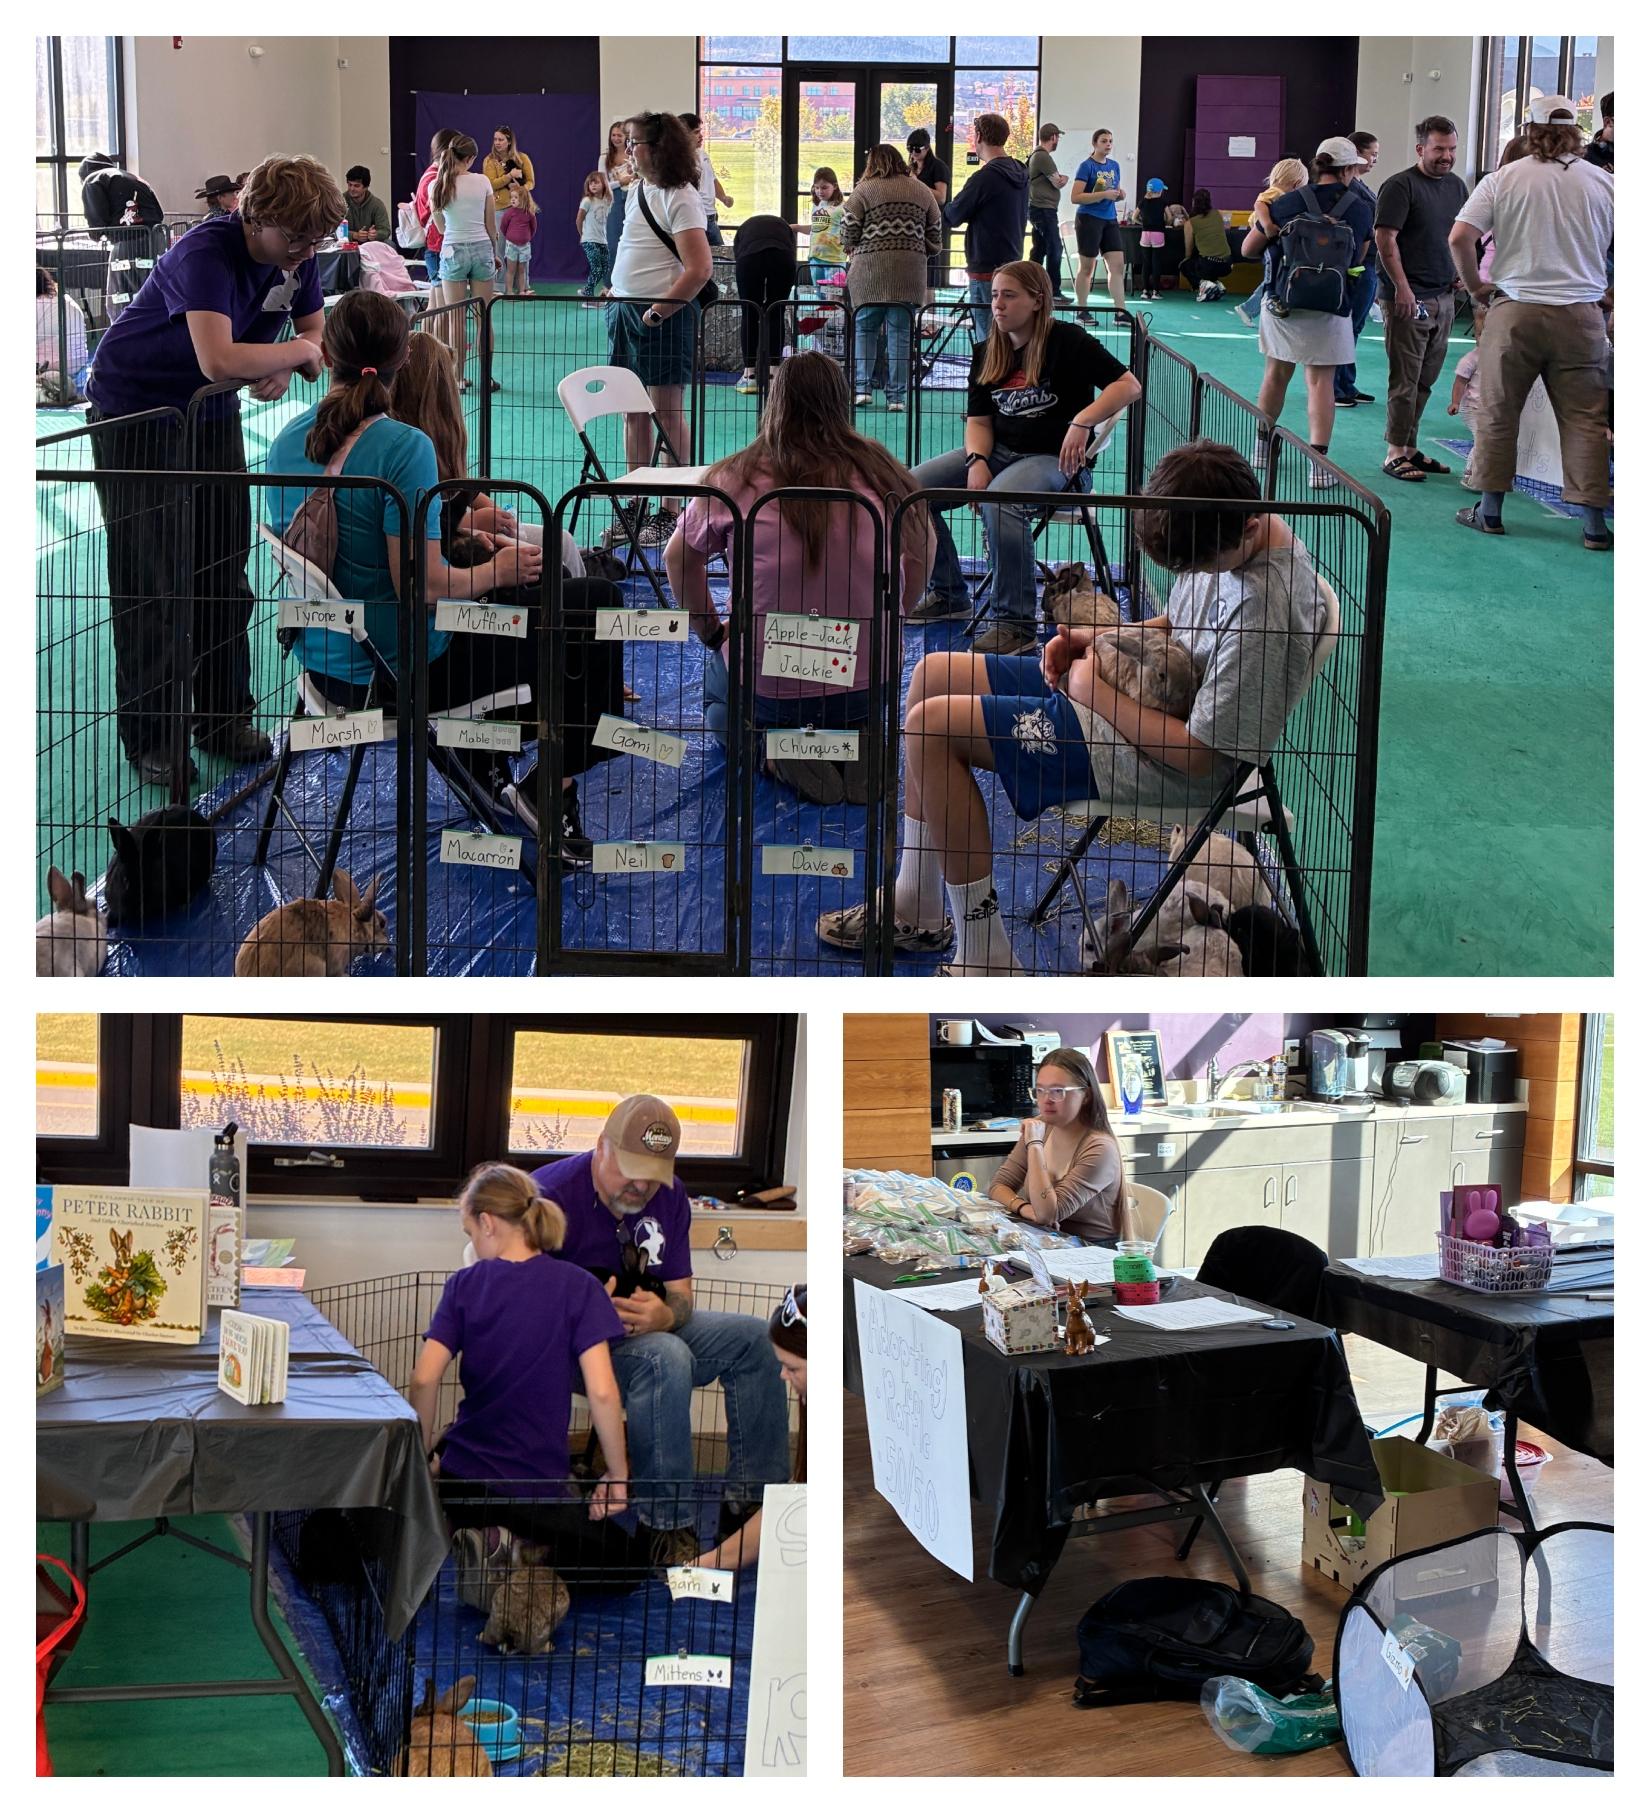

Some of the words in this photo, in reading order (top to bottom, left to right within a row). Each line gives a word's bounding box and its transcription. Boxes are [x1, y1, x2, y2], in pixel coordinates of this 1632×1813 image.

[294, 606, 336, 624] Tyrone
[456, 606, 512, 632] Muffin
[609, 614, 661, 637] Alice
[779, 654, 833, 679] Jackie
[311, 722, 362, 745] Marsh
[611, 727, 651, 753] Gomi
[779, 737, 840, 759] Chungus
[447, 839, 515, 866] Macarron
[615, 848, 649, 869] Neil
[792, 850, 829, 872] Dave
[63, 1199, 120, 1217] PETER
[127, 1203, 193, 1222] RABBIT
[867, 1294, 948, 1420] Adopting
[886, 1436, 939, 1541] 50/50
[1386, 1642, 1403, 1675] Gizmo
[654, 1664, 703, 1682] Mittens
